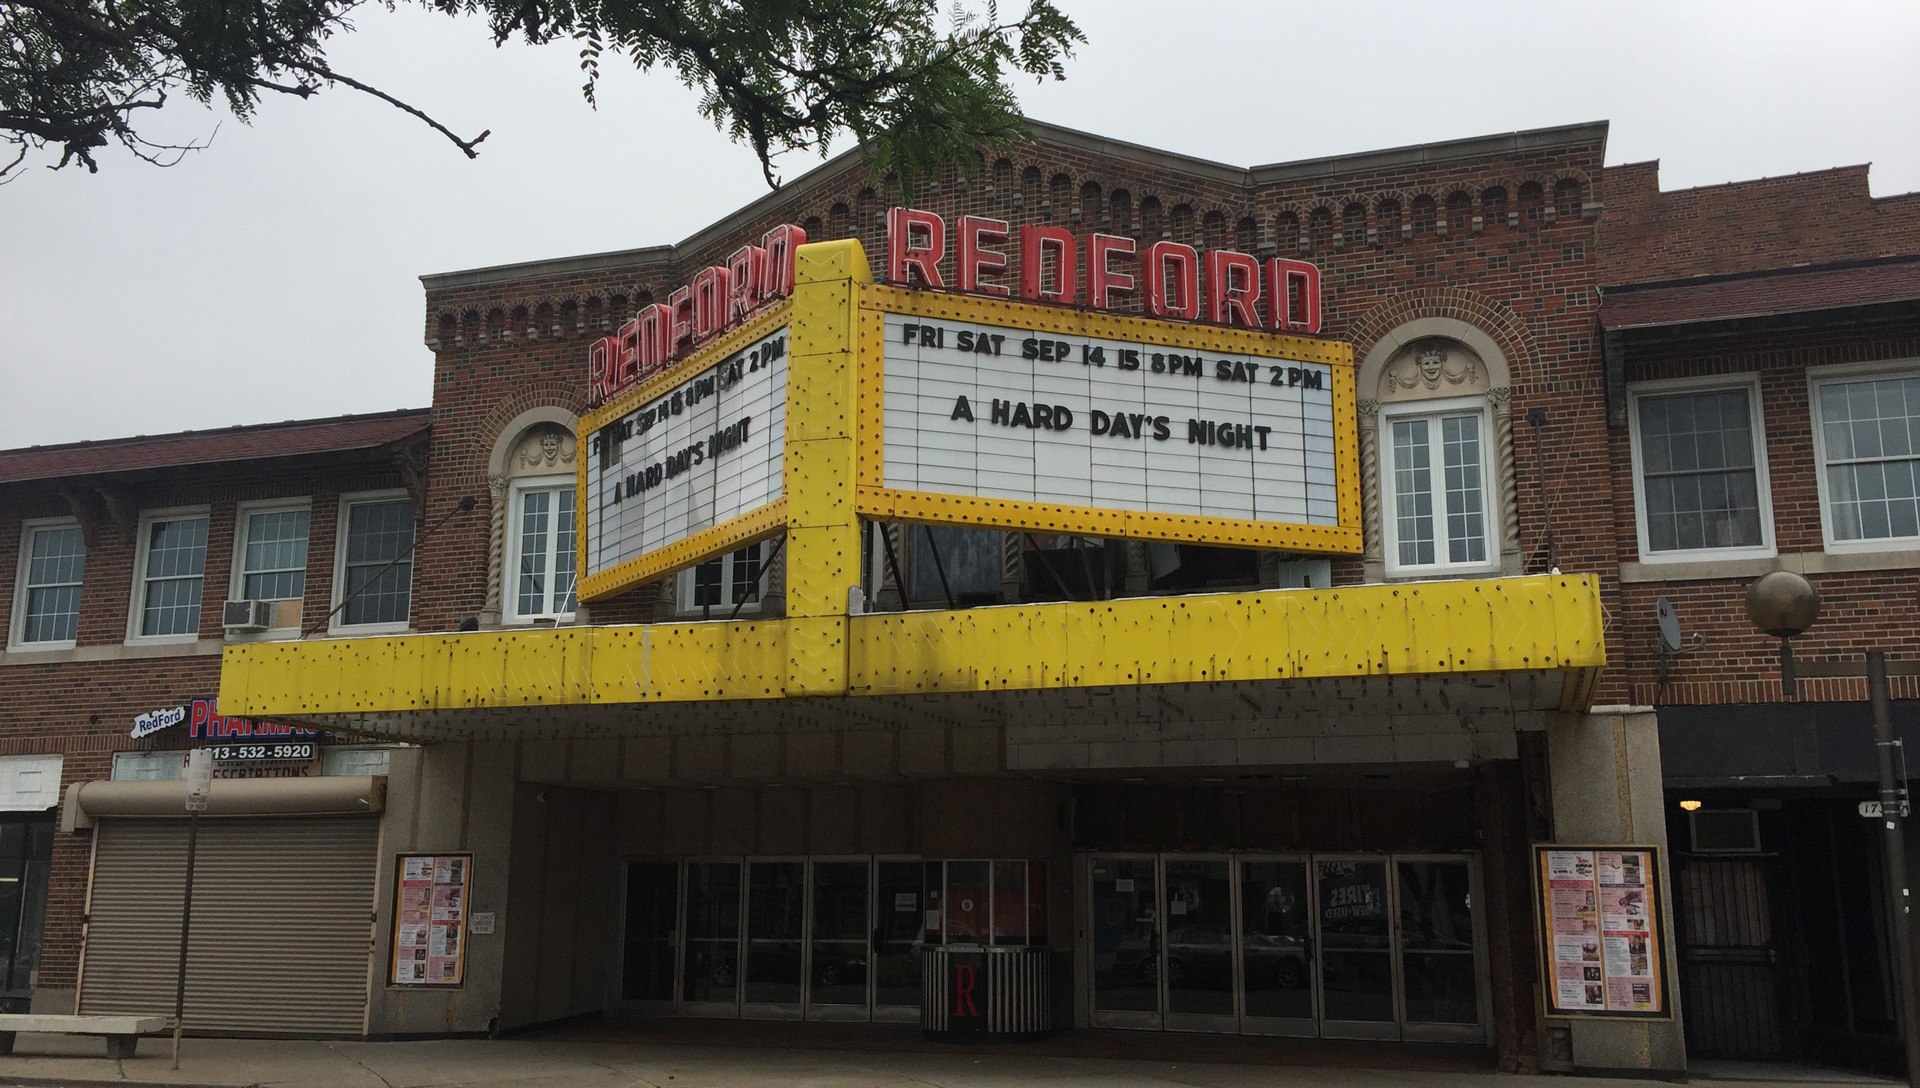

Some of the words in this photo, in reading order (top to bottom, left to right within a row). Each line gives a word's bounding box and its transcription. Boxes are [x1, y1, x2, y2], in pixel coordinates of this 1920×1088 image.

[887, 207, 1321, 334] REDFORD
[588, 223, 806, 411] REDFORD
[903, 323, 944, 349] FRI
[957, 330, 1005, 356] SAT
[1022, 338, 1071, 363] SEP
[1083, 344, 1106, 367] 14
[1118, 349, 1140, 371] 15
[1216, 360, 1259, 383] SAT
[636, 408, 656, 436] SEP
[719, 358, 744, 391] SAT
[951, 395, 974, 422] A
[992, 398, 1073, 431] HARD
[1091, 409, 1171, 441] DAY'S
[1189, 419, 1271, 451] NIGHT
[614, 482, 622, 504] A
[626, 463, 662, 498] HARD
[665, 441, 704, 479] DAY'S
[708, 416, 751, 458] NIGHT
[139, 709, 181, 732] RedFord
[205, 745, 311, 759] 13-532-5920
[953, 964, 979, 1017] R
